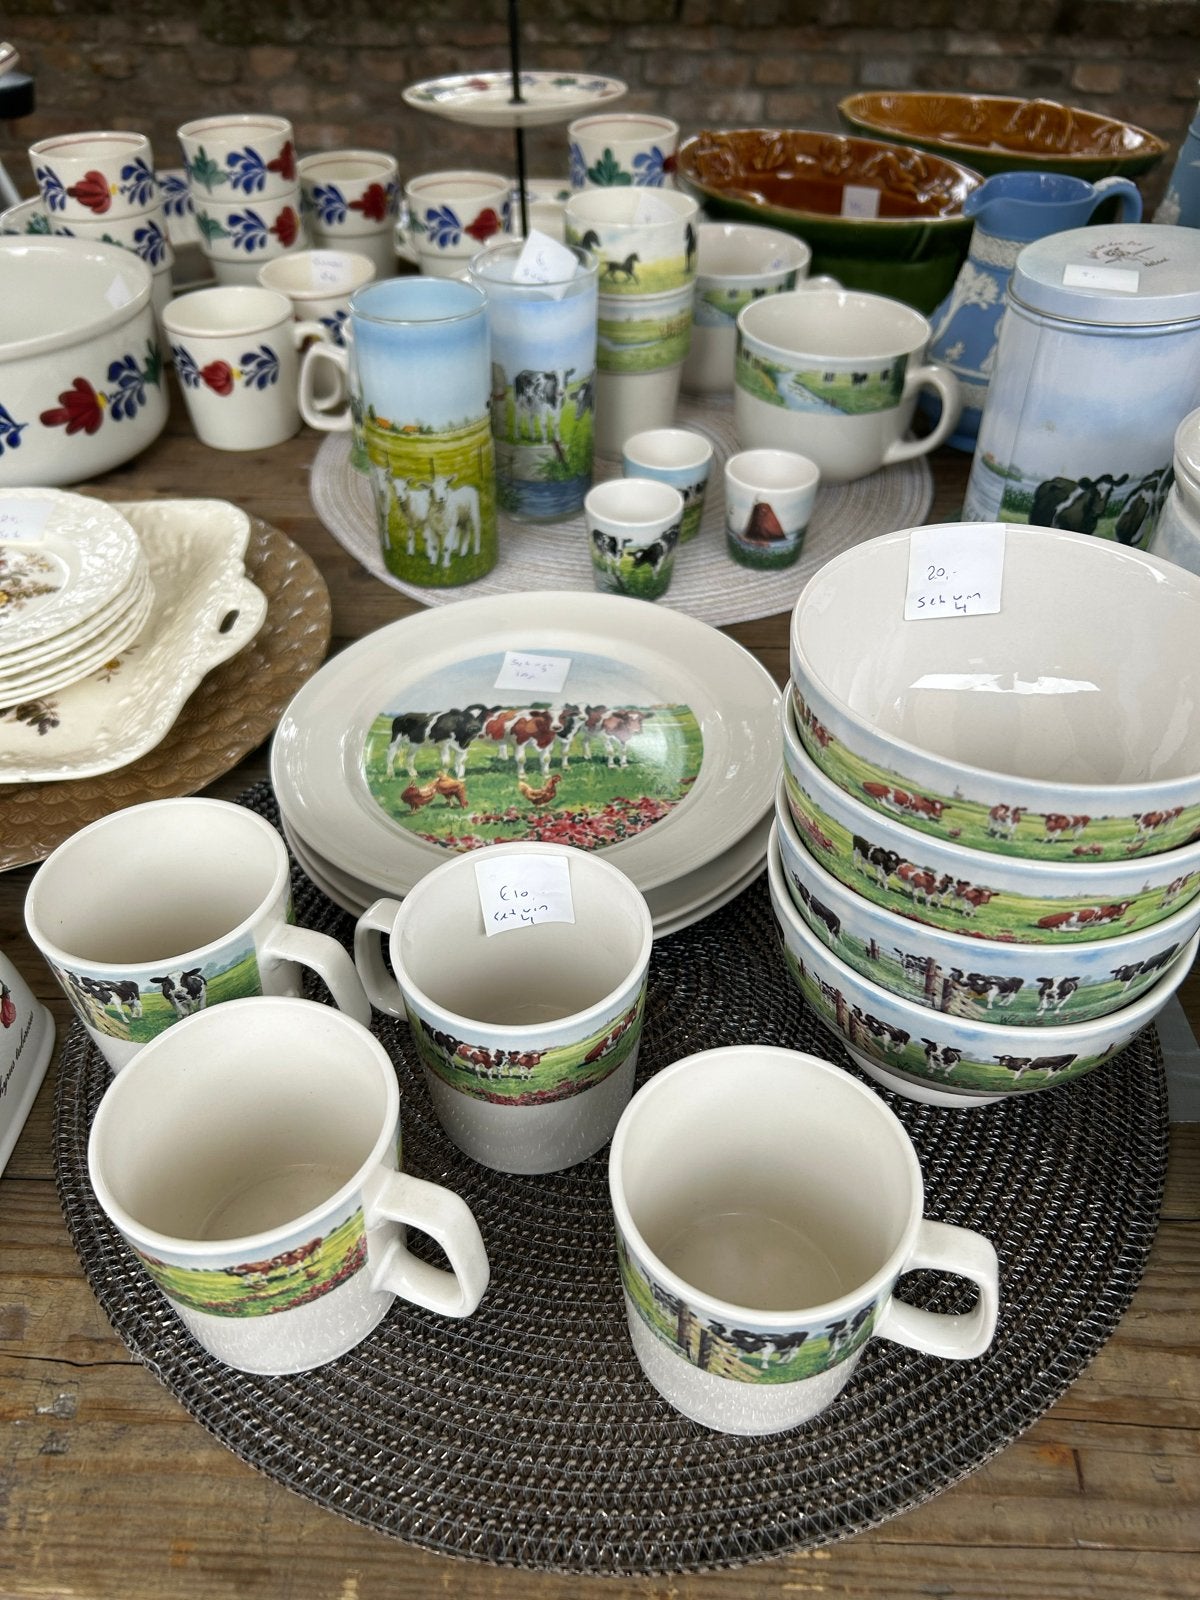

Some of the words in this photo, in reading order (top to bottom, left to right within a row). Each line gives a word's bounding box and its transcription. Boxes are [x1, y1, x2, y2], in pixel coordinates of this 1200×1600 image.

[927, 565, 957, 580] 20,-
[954, 601, 967, 613] 4
[520, 914, 535, 924] 4
